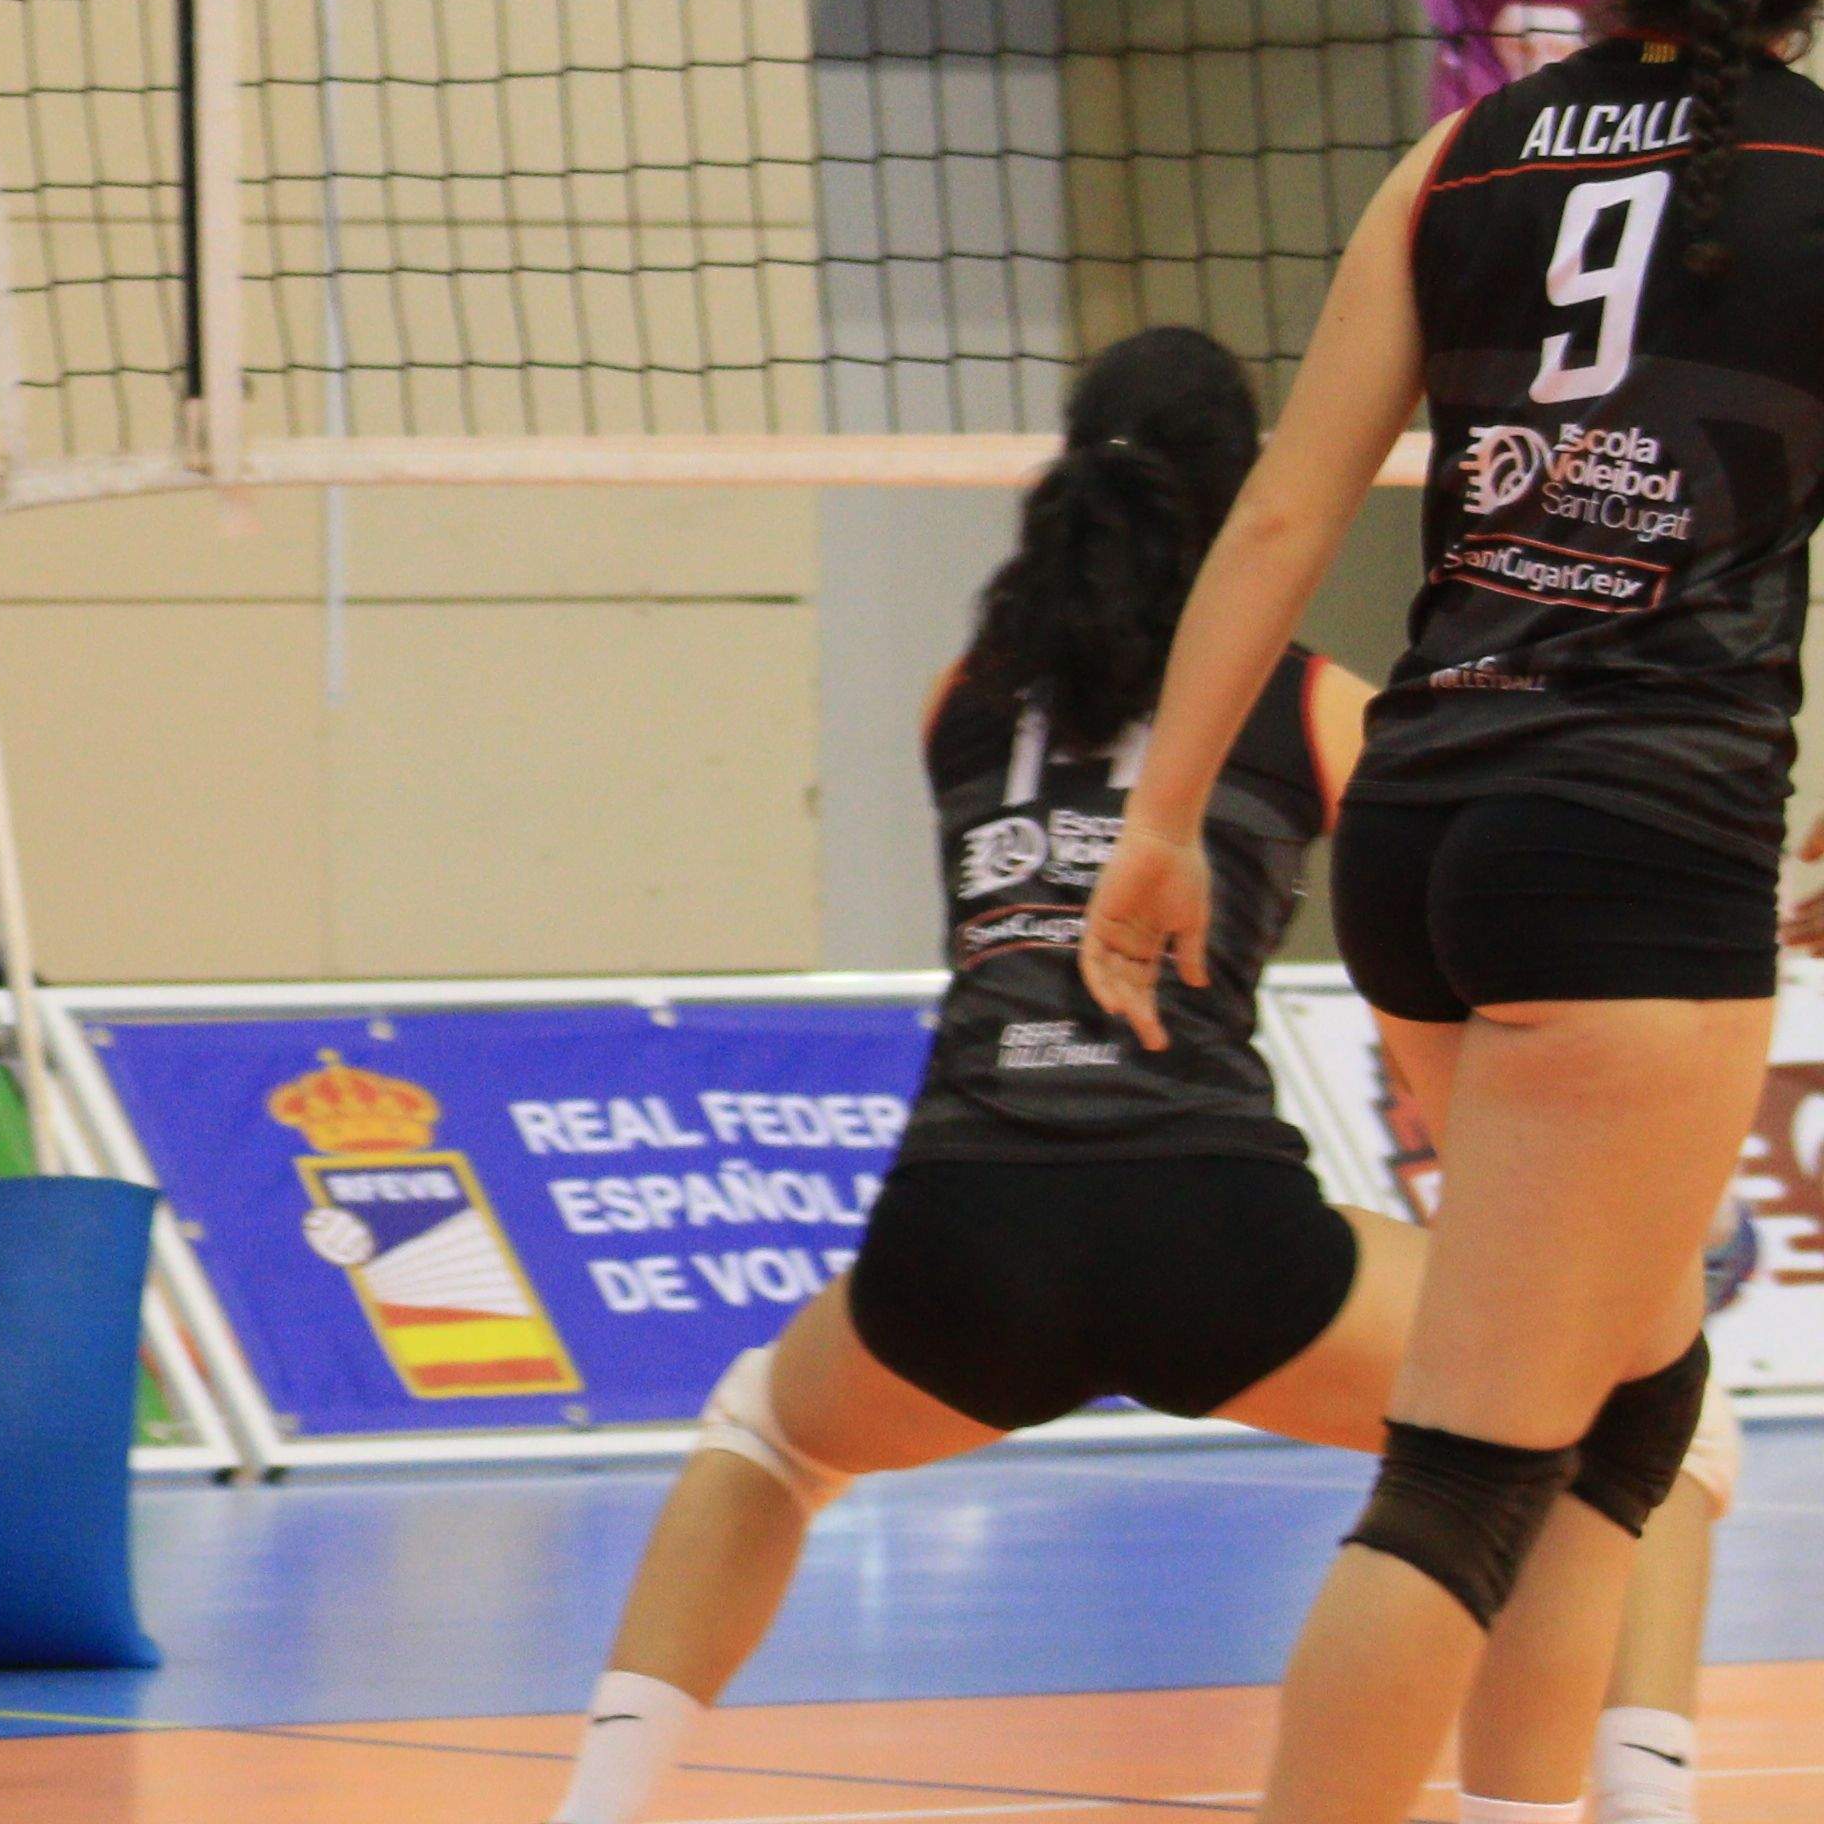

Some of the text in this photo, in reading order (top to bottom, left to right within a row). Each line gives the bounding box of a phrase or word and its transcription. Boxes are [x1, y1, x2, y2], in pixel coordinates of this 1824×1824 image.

[1528, 170, 1674, 405] 9
[508, 1096, 708, 1155] REAL
[587, 1254, 701, 1314] DE
